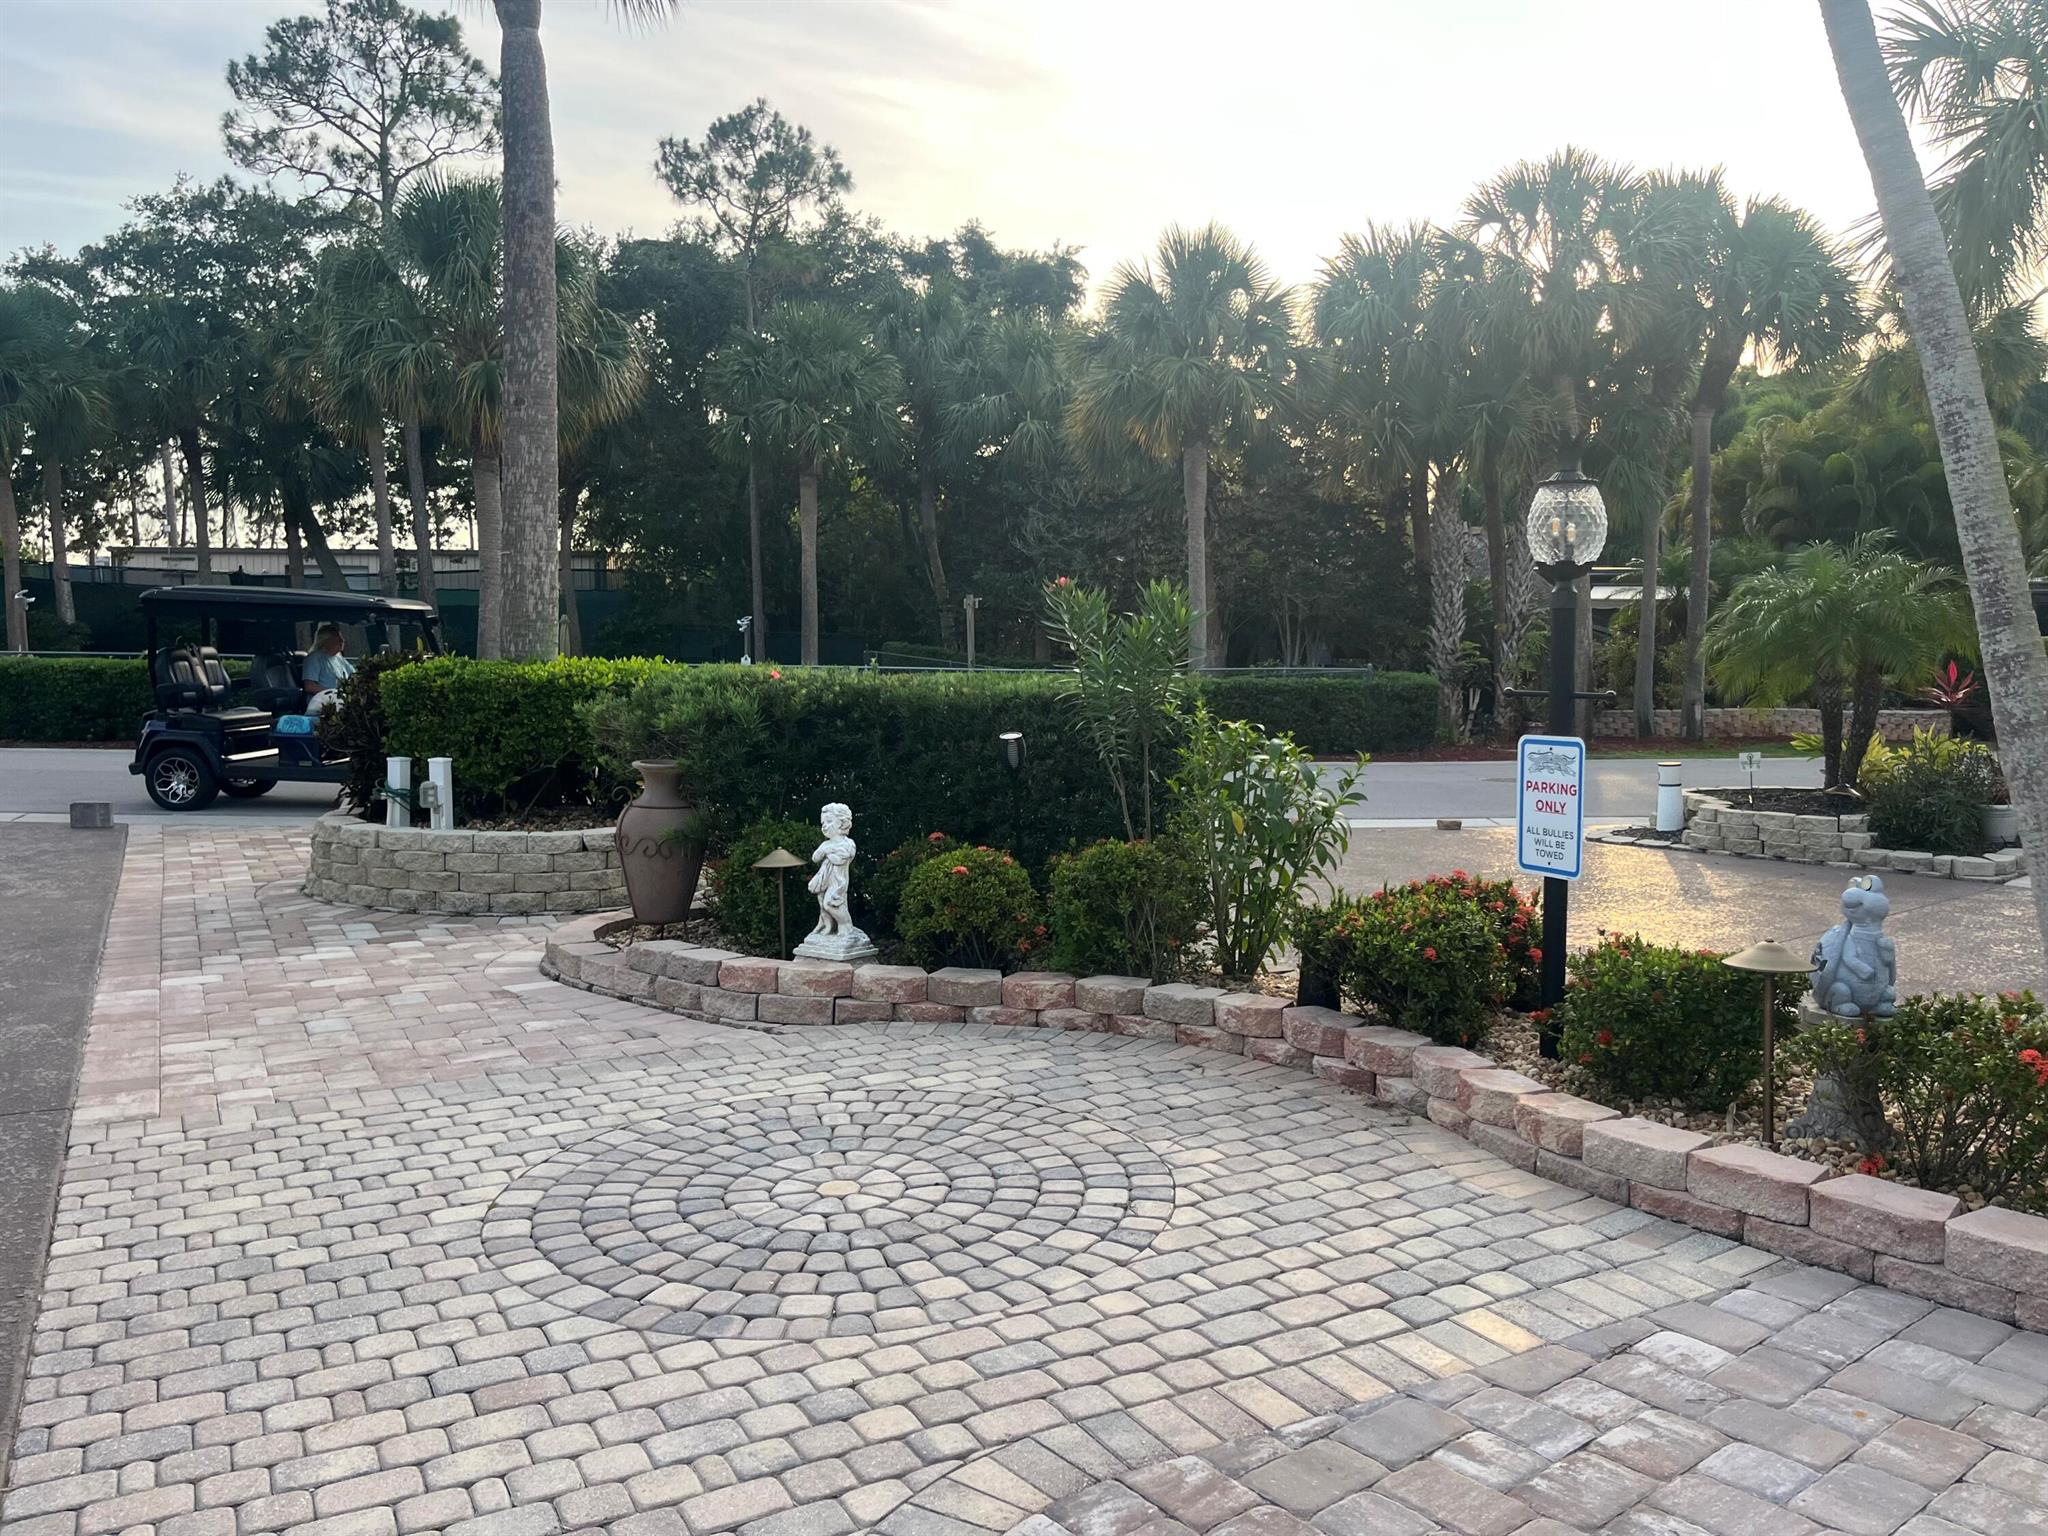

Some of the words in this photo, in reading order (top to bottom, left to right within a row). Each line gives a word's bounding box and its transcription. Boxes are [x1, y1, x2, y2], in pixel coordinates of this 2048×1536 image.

[1526, 780, 1577, 796] PARKING
[1535, 799, 1567, 814] ONLY
[1526, 826, 1540, 836] ALL
[1542, 828, 1574, 840] BULLIES
[1534, 838, 1554, 848] WILL
[1555, 840, 1566, 850] BE
[1535, 848, 1564, 860] TOWED
